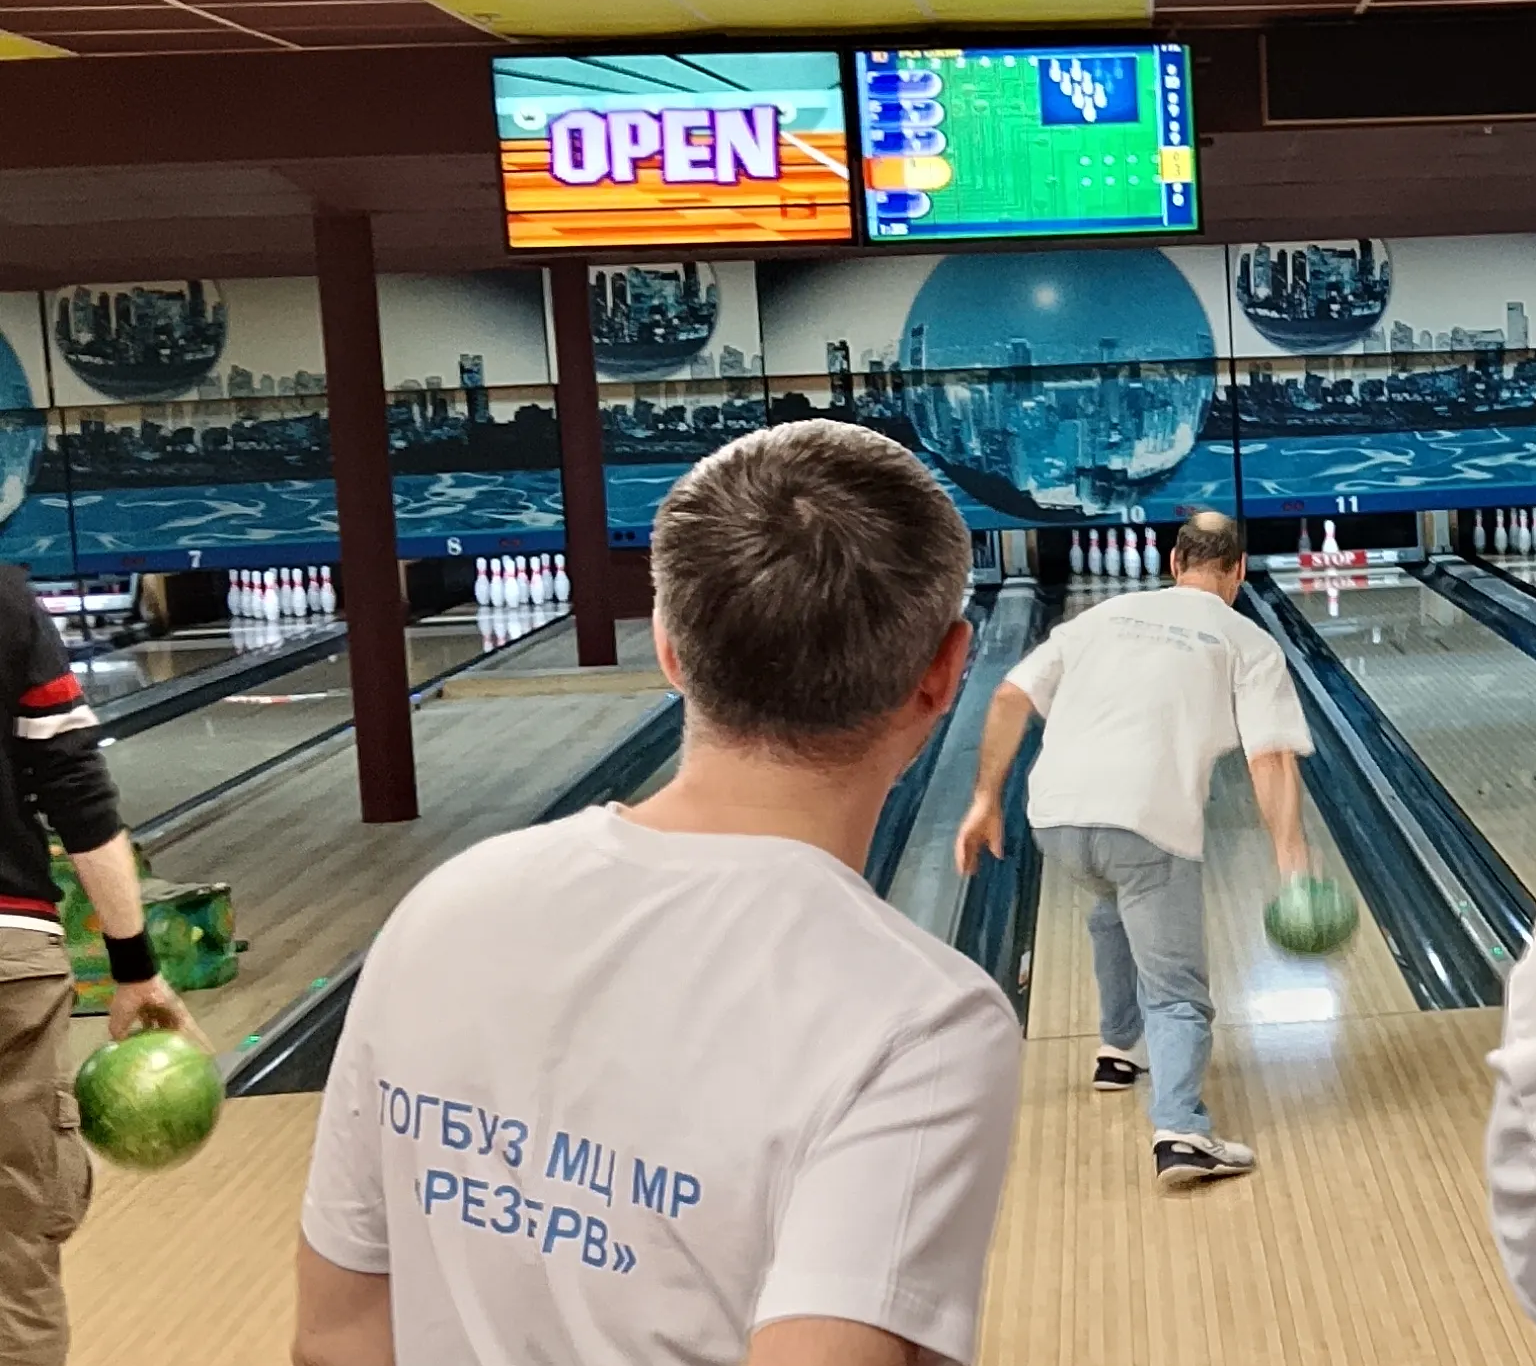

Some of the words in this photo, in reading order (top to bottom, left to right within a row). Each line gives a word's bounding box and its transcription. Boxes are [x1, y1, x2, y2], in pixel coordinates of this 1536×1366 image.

[550, 104, 781, 186] OPEN
[1335, 495, 1359, 514] 11
[1120, 505, 1146, 524] 10
[446, 537, 462, 555] 8
[188, 550, 203, 568] 7
[1311, 551, 1356, 567] STOP
[379, 1079, 529, 1167] ТОГБУЗ
[545, 1131, 616, 1206] МЦ
[632, 1157, 702, 1218] МР
